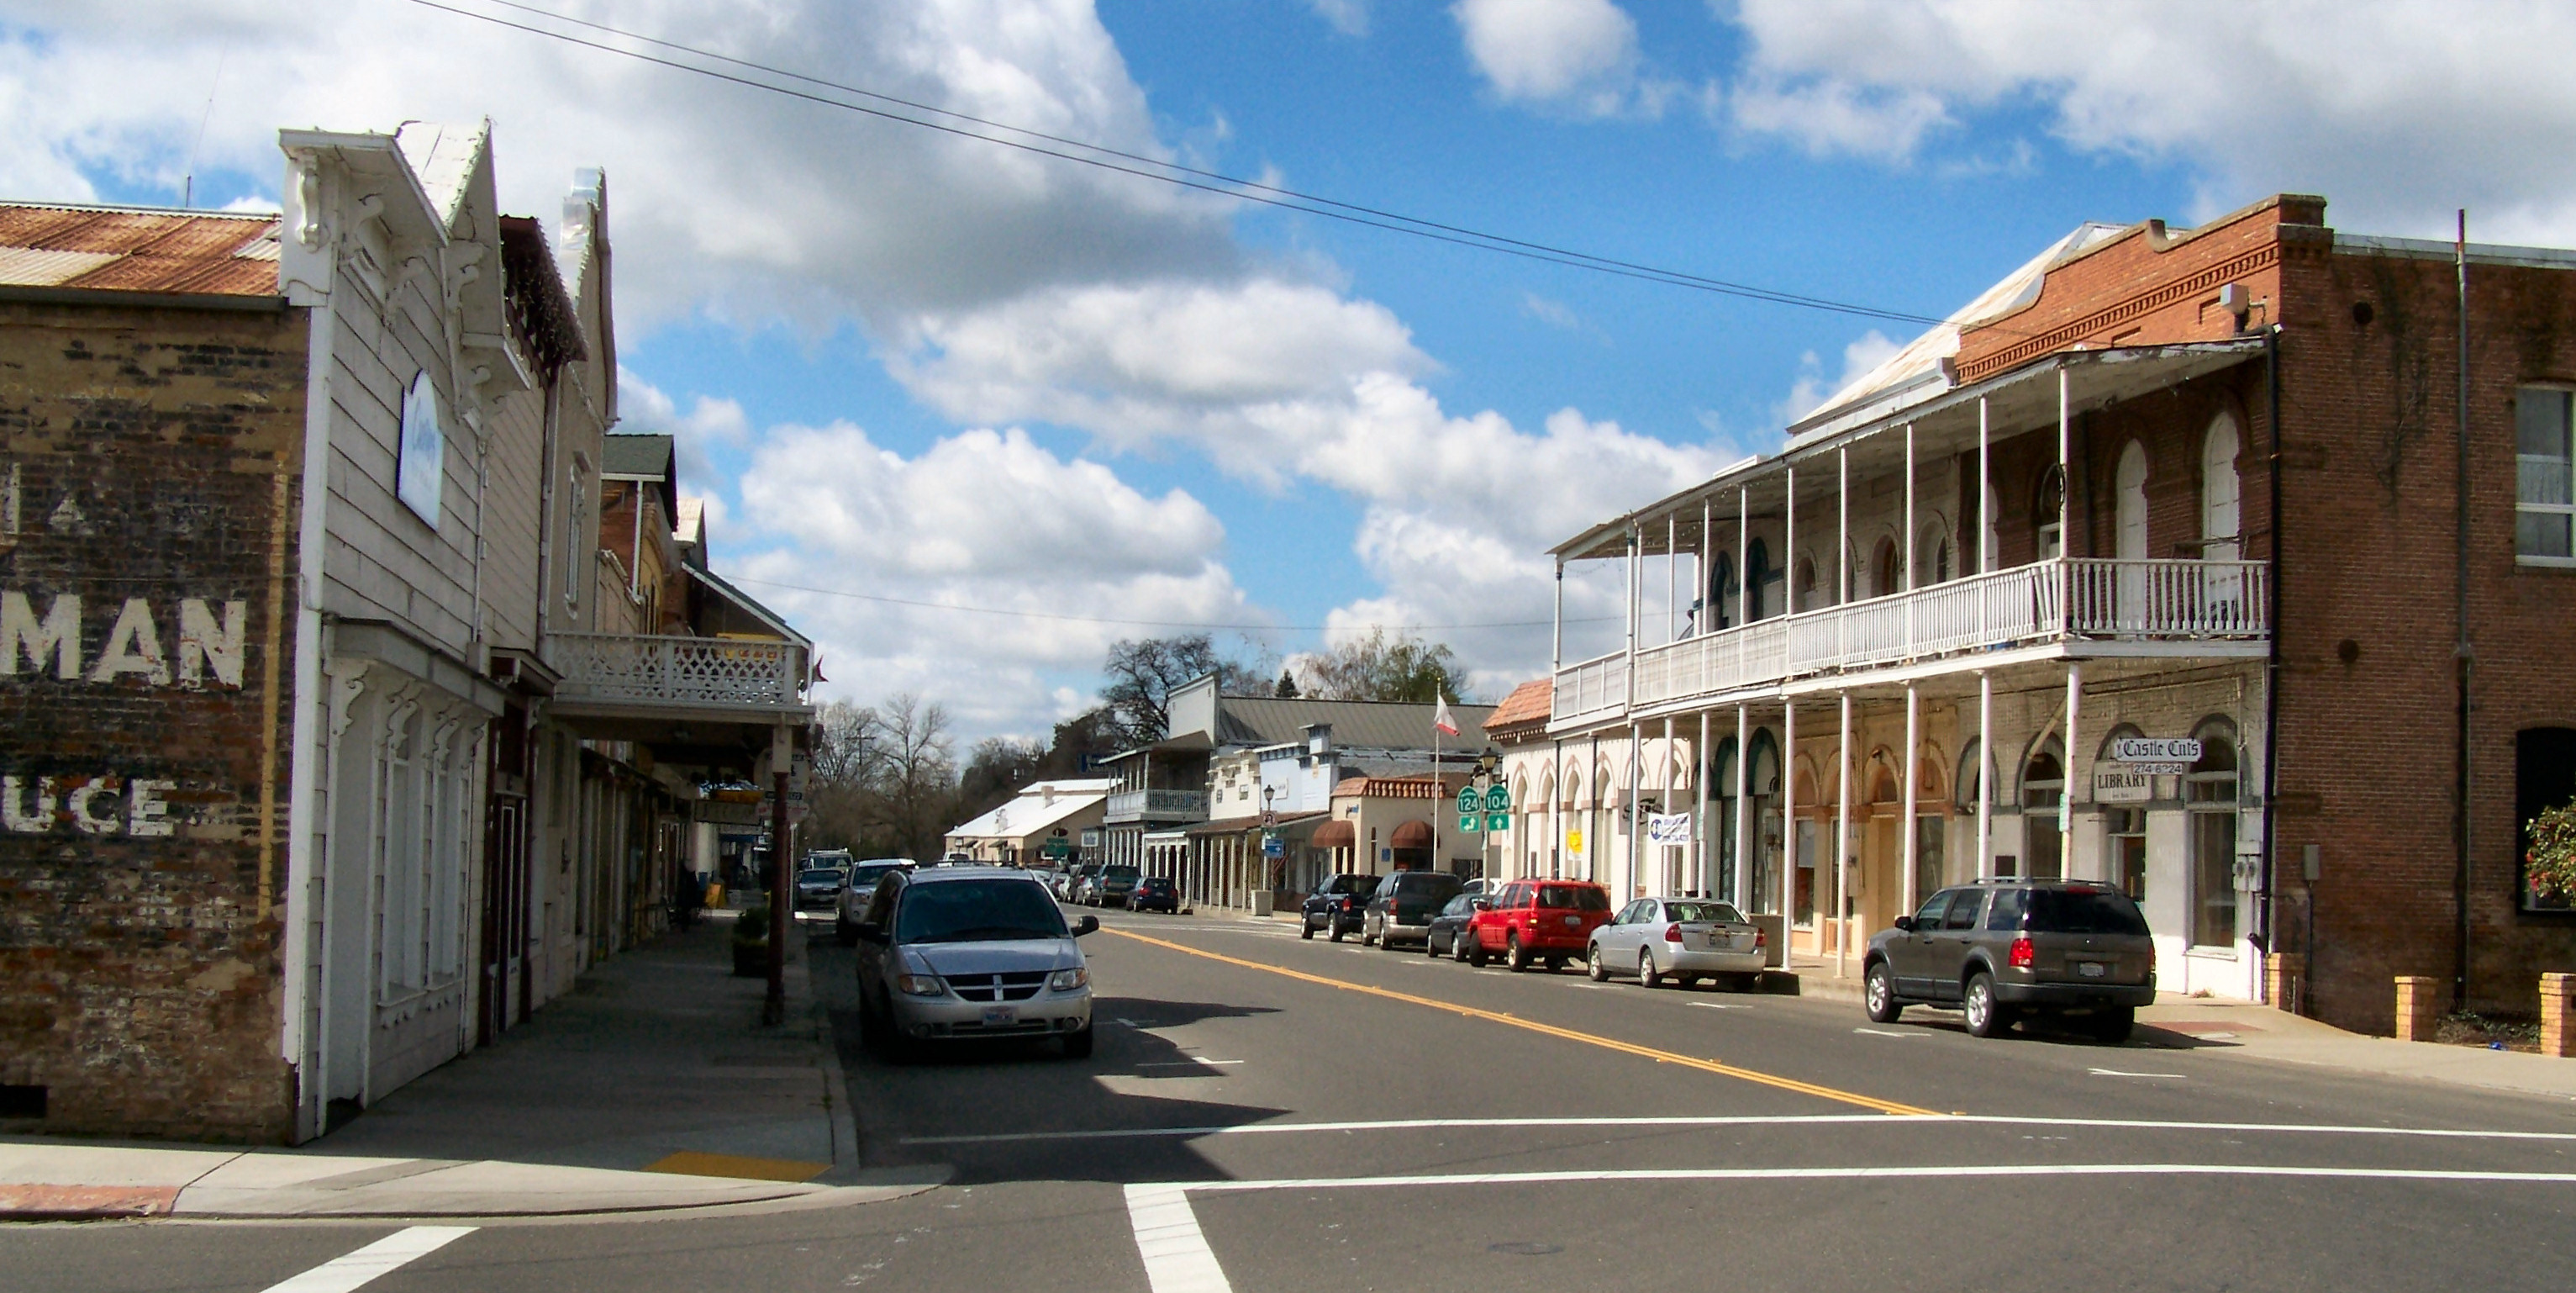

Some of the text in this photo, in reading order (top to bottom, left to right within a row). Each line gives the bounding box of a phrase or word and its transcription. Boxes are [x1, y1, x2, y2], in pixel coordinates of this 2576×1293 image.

[0, 591, 247, 691] MAN
[2123, 740, 2163, 757] Castle
[2098, 773, 2146, 789] LIBRARY
[1459, 797, 1478, 811] 124
[1487, 795, 1509, 809] 104
